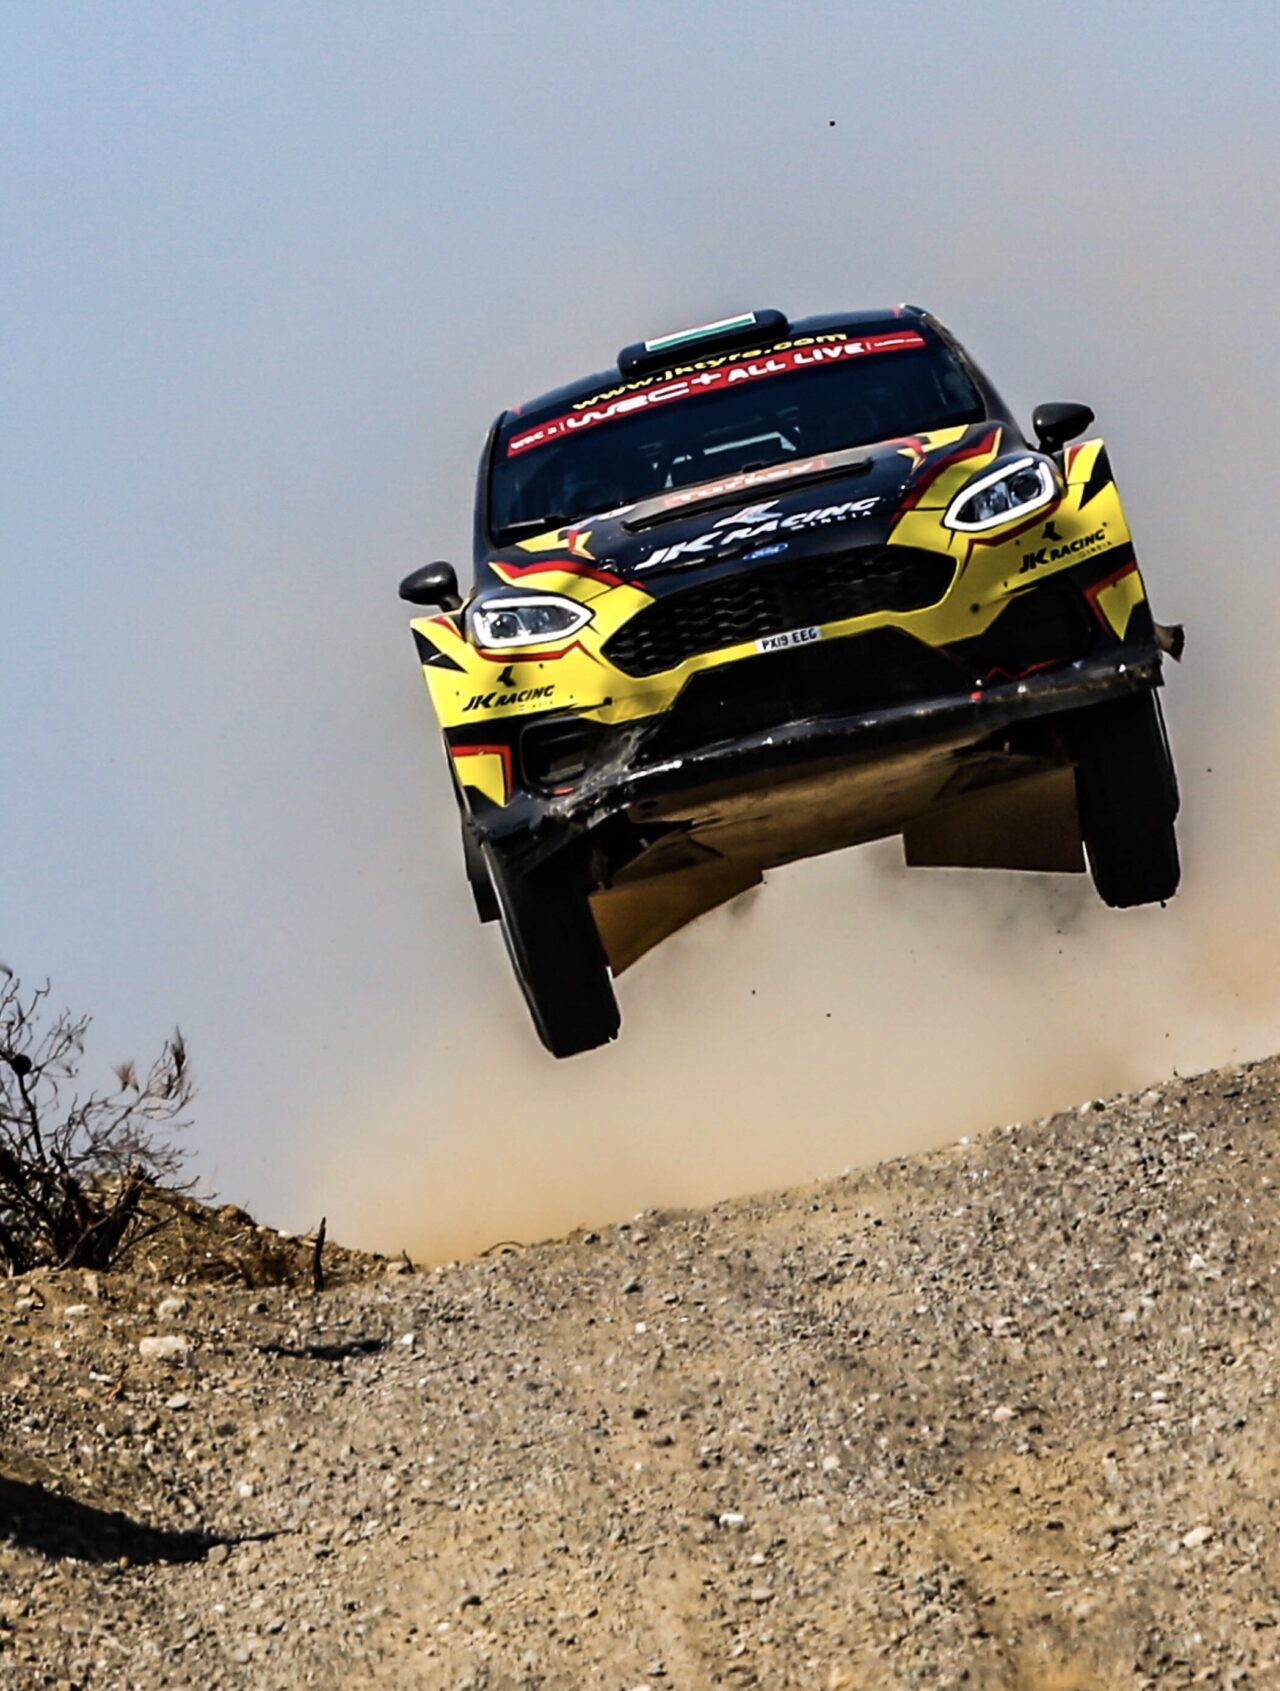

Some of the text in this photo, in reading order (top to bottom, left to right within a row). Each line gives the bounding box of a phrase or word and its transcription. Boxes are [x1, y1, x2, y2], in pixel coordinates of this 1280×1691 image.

[728, 360, 786, 382] ALL
[793, 342, 864, 364] LIVE
[634, 497, 881, 571] JK RACING
[1019, 528, 1106, 574] JK RACING
[761, 634, 789, 651] PX19
[462, 691, 498, 712] JK
[494, 684, 556, 708] RACING
